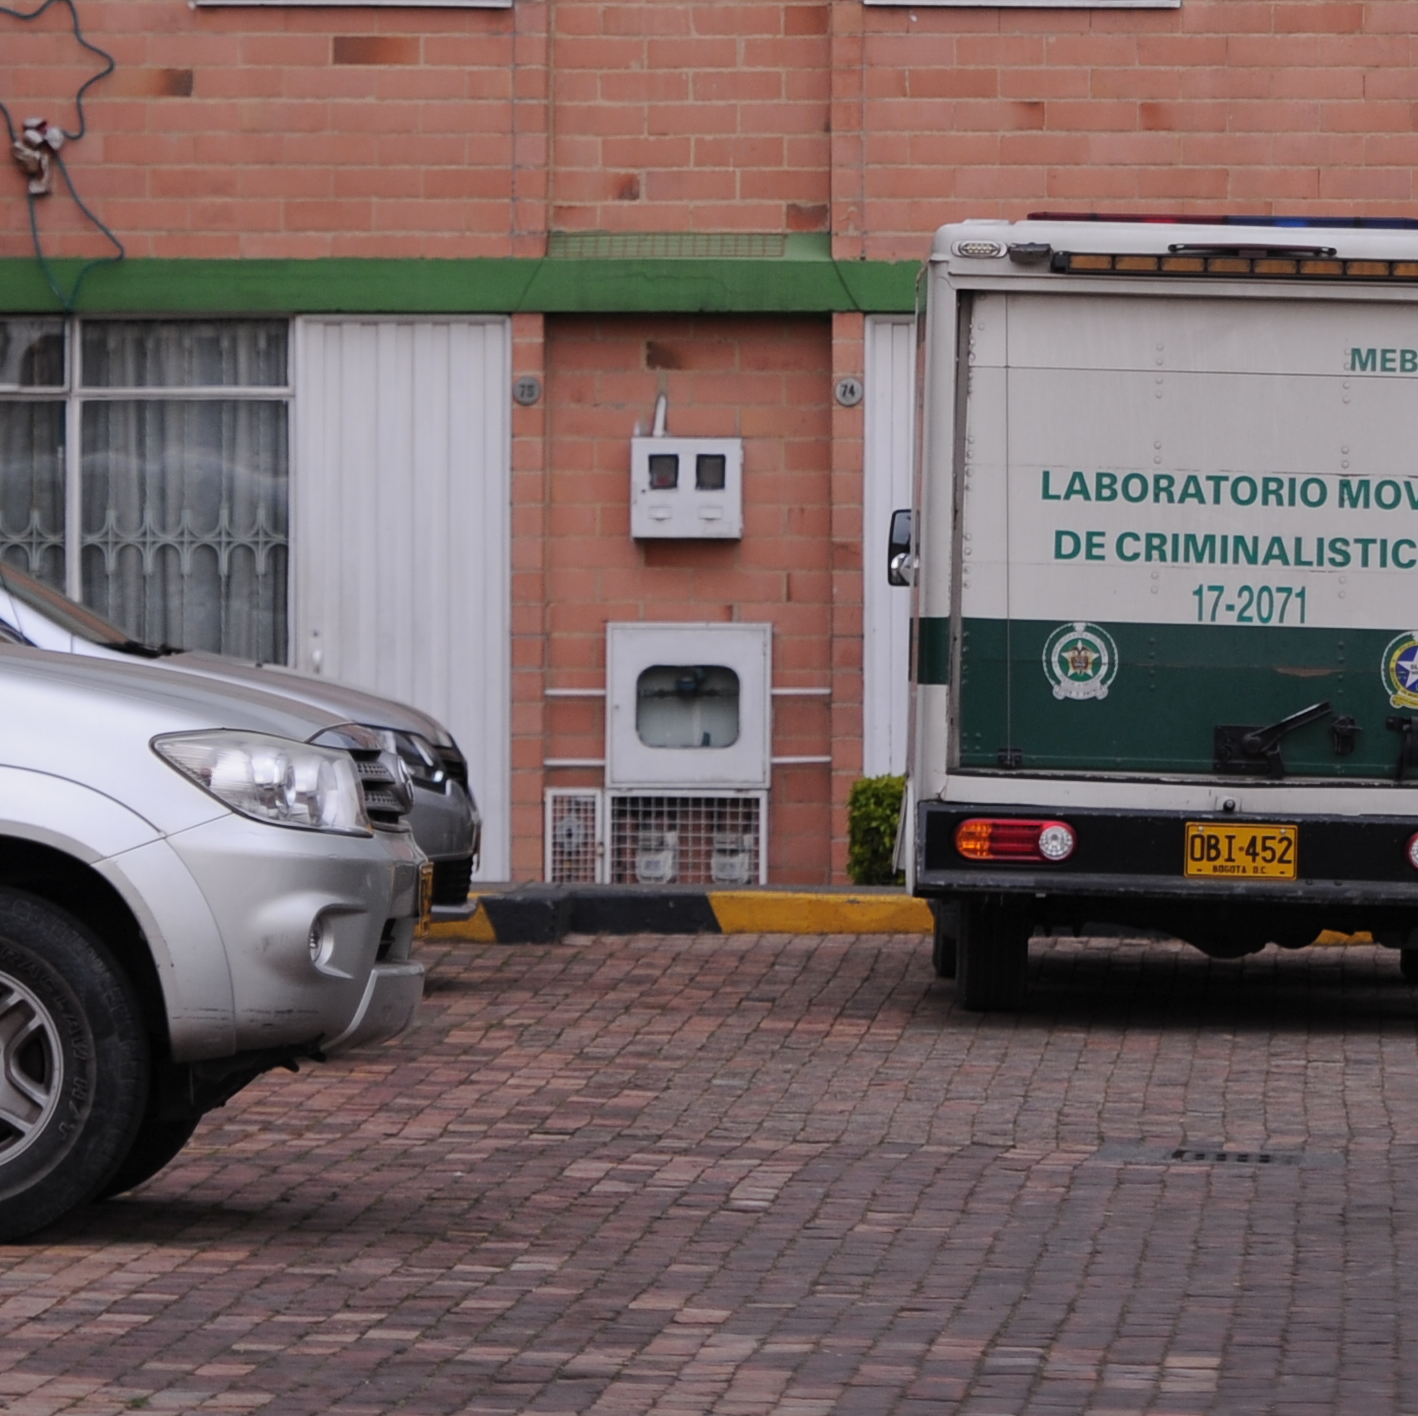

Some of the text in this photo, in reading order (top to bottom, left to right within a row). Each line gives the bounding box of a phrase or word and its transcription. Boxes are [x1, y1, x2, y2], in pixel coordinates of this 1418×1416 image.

[840, 383, 856, 398] 74
[1041, 471, 1328, 509] LABORATORIO
[1054, 530, 1106, 561] DE
[1192, 585, 1307, 624] 17-2071
[1212, 865, 1247, 874] BOGOTA
